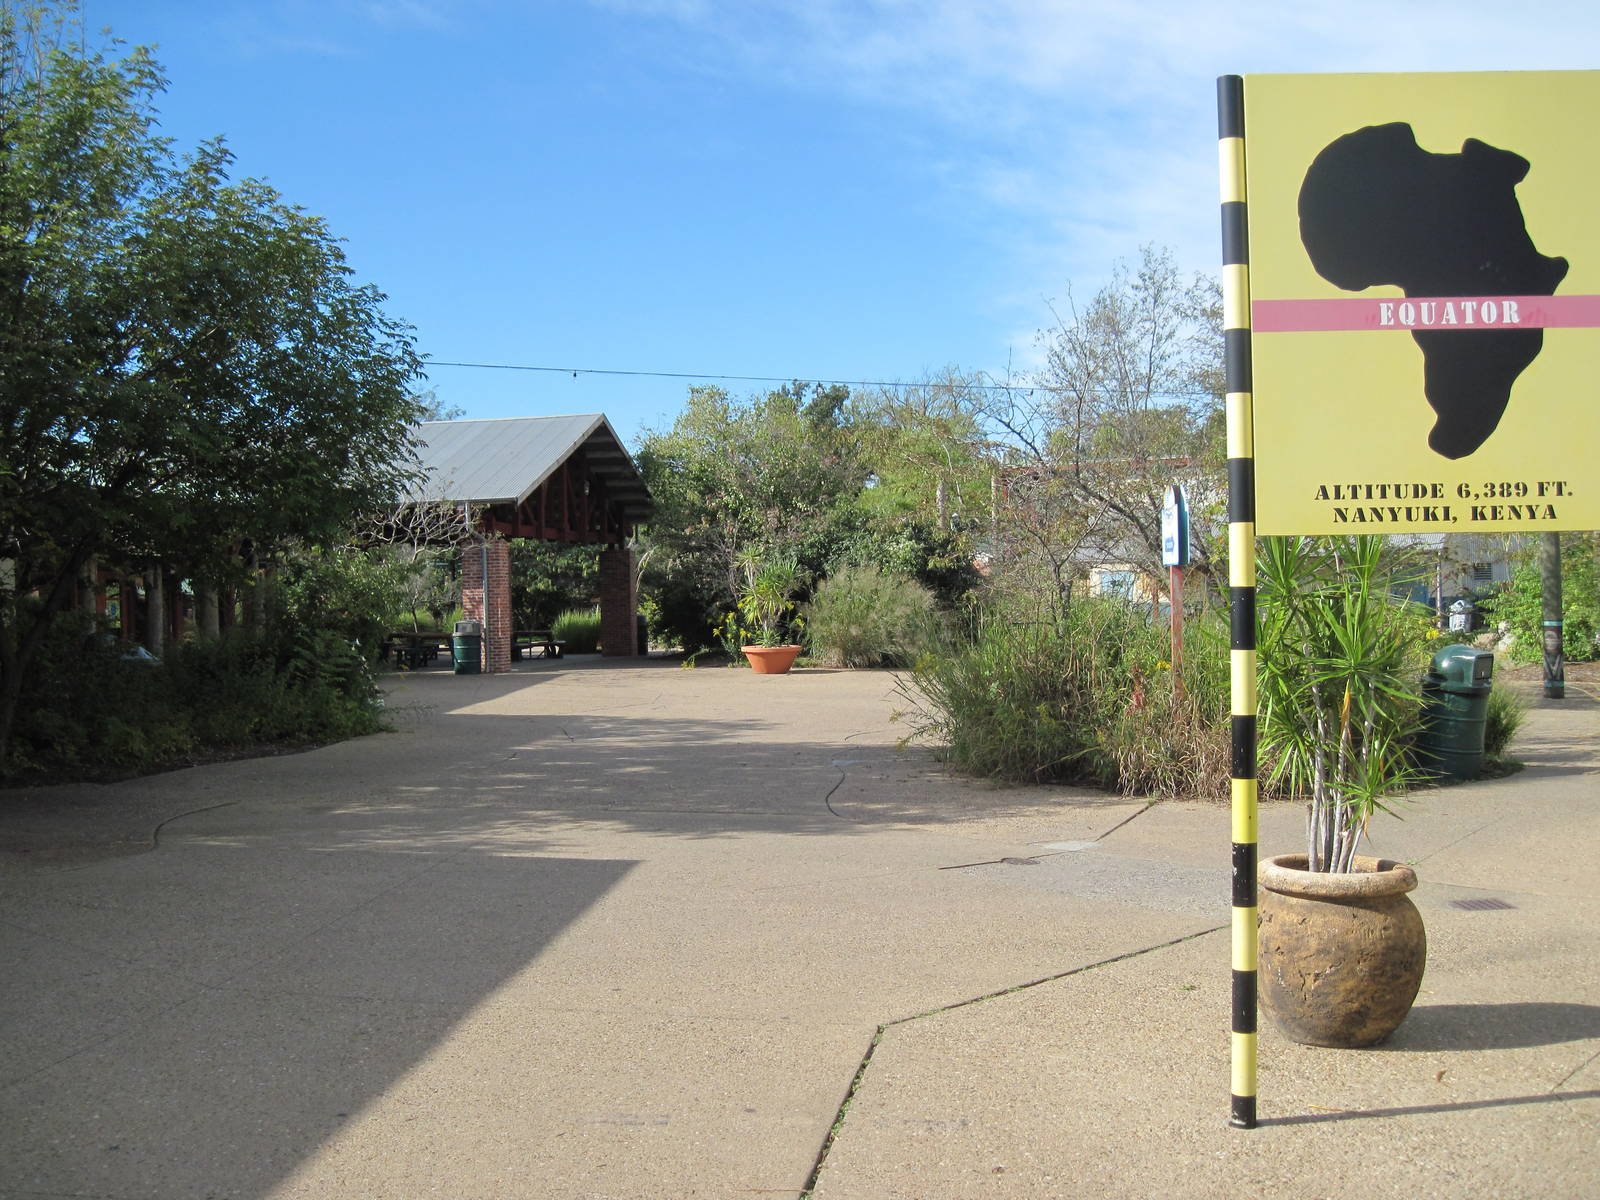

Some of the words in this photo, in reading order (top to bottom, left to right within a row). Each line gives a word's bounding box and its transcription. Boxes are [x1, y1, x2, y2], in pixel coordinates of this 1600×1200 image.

[1379, 301, 1521, 326] EQUATOR
[1314, 483, 1444, 501] ALTITUDE
[1456, 482, 1529, 500] 6,389
[1537, 481, 1573, 497] FT.
[1333, 505, 1458, 524] NANYUKI,
[1471, 504, 1558, 521] KENYA
